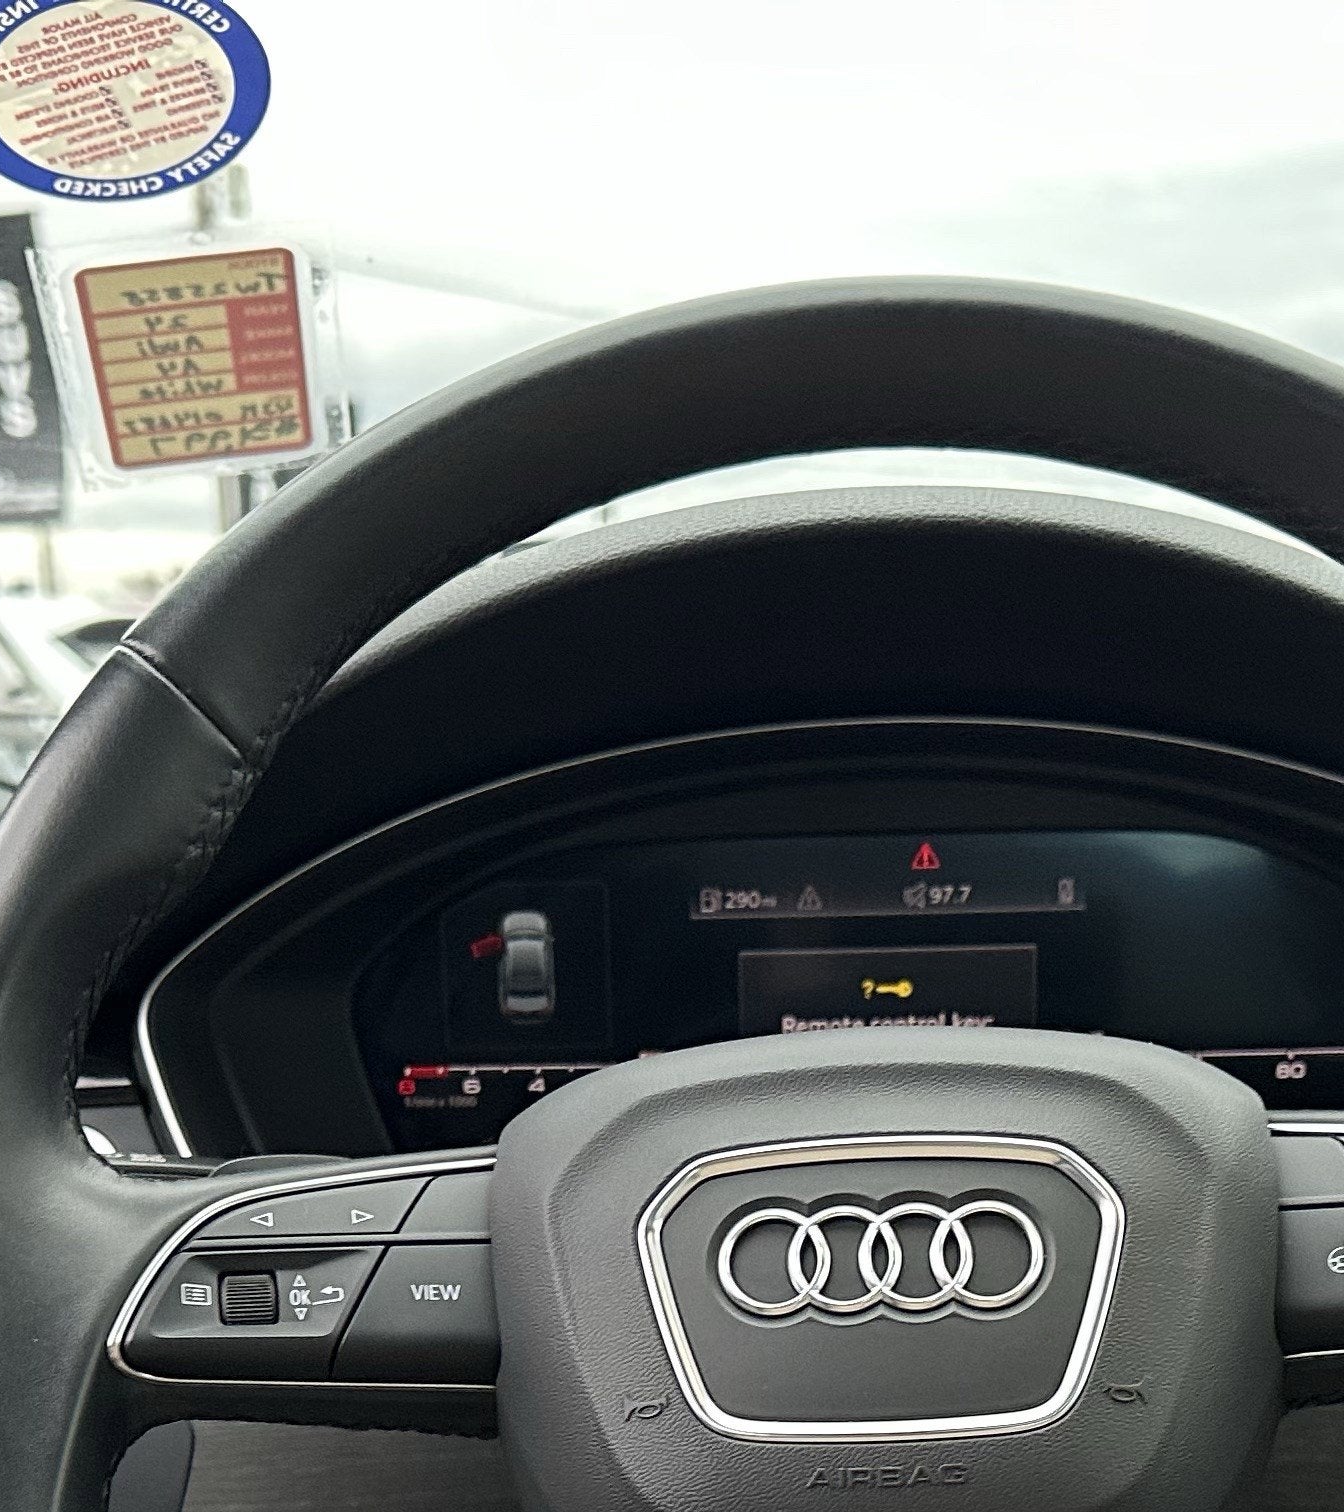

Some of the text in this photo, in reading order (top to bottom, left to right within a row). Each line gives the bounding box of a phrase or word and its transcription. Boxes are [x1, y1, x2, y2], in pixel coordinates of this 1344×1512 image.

[724, 891, 760, 909] 290
[928, 884, 972, 904] 97.7
[289, 1289, 311, 1306] OK
[410, 1284, 461, 1301] VIEW
[805, 1462, 968, 1488] AIRBAG
